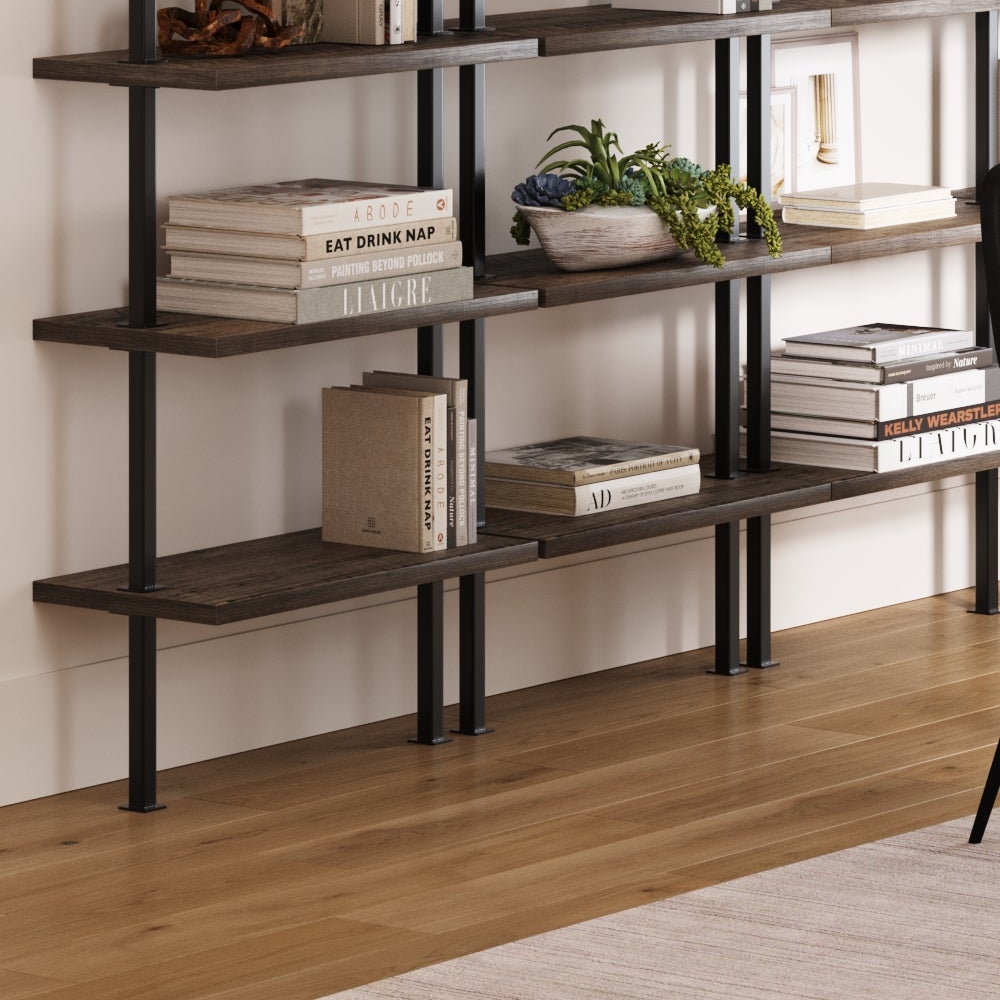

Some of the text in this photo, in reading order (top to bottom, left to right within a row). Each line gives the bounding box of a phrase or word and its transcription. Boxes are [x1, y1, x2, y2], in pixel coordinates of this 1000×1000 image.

[353, 201, 413, 222] ABODE
[325, 226, 436, 254] EAT DRINK NAP
[331, 260, 370, 278] PAINTING
[372, 256, 405, 273] BEYOND
[407, 251, 445, 269] POLLOCK
[342, 276, 432, 316] LIAIGRE
[898, 340, 944, 355] MINIMAL
[925, 361, 944, 373] Inspired
[952, 354, 978, 368] Nature
[916, 391, 937, 402] Breuer
[884, 418, 923, 437] KELLY
[436, 447, 445, 510] ABODE
[448, 495, 456, 528] Nature
[586, 488, 612, 512] AD
